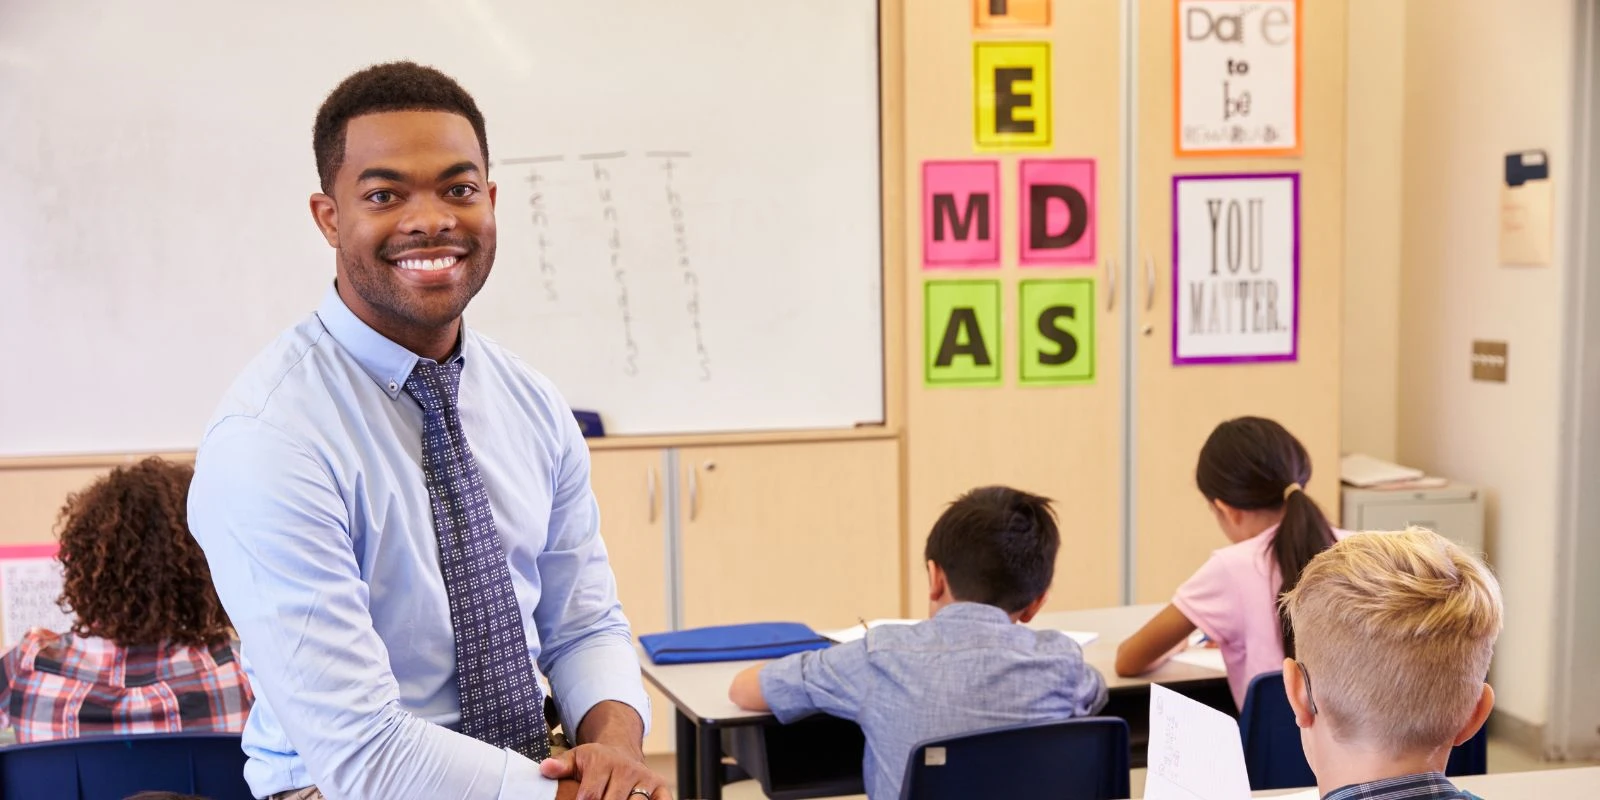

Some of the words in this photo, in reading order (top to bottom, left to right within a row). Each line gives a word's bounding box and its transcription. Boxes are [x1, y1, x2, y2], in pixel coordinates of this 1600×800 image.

[1186, 4, 1290, 47] Dare
[1227, 58, 1249, 75] to
[993, 66, 1036, 134] E
[1223, 80, 1251, 121] be
[932, 193, 990, 242] M
[1029, 184, 1089, 250] D
[1207, 198, 1264, 275] YOU
[934, 307, 992, 367] A
[1037, 305, 1079, 365] S
